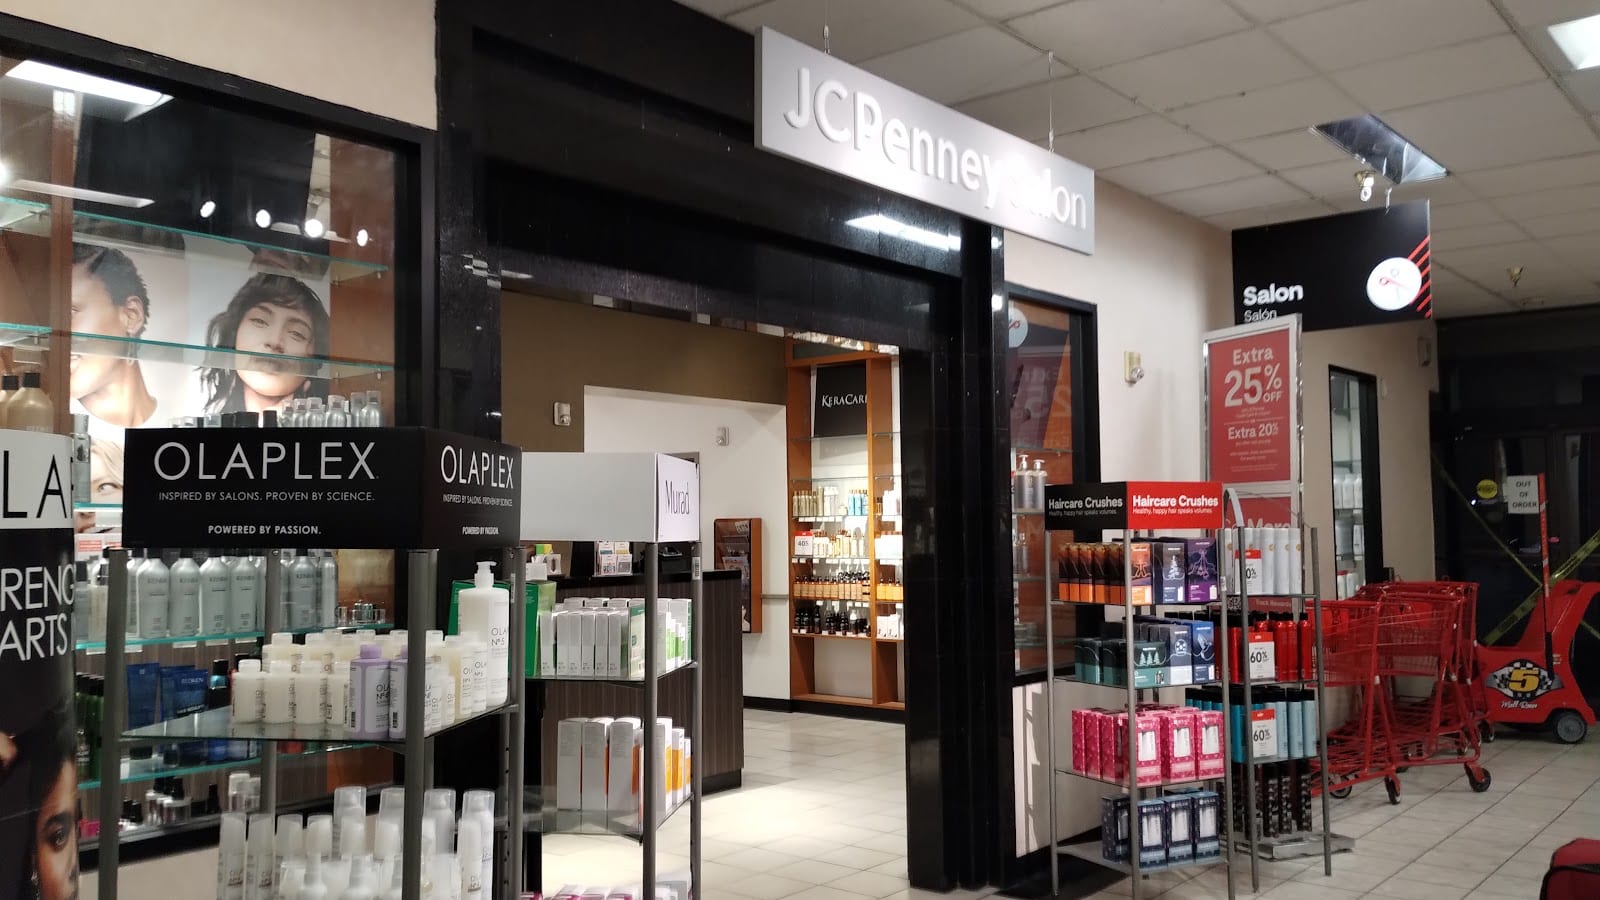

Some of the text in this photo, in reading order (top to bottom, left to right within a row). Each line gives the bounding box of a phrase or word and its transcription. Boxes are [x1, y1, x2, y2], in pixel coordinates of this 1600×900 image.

[783, 67, 1086, 229] JCPenney lon
[1243, 282, 1303, 306] Salon
[1244, 307, 1277, 323] Salón
[1233, 347, 1273, 365] Extra
[1225, 363, 1282, 408] 25%
[1263, 391, 1282, 402] OFF
[1228, 426, 1256, 440] Extra
[154, 442, 376, 480] OLAPLEX
[441, 445, 514, 489] OLAPLEX
[3, 450, 73, 518] LA
[159, 491, 375, 501] INSPIRED BY SALONS. PROVEN BY SCIENCE.
[665, 480, 689, 514] Murad
[1049, 496, 1123, 510] Haircare Crushes
[1132, 495, 1219, 507] Haircare Crushes
[208, 525, 322, 534] POWERED BY PASSION.
[1250, 651, 1268, 663] 60%
[1509, 669, 1540, 692] 5
[1253, 729, 1271, 742] 60%
